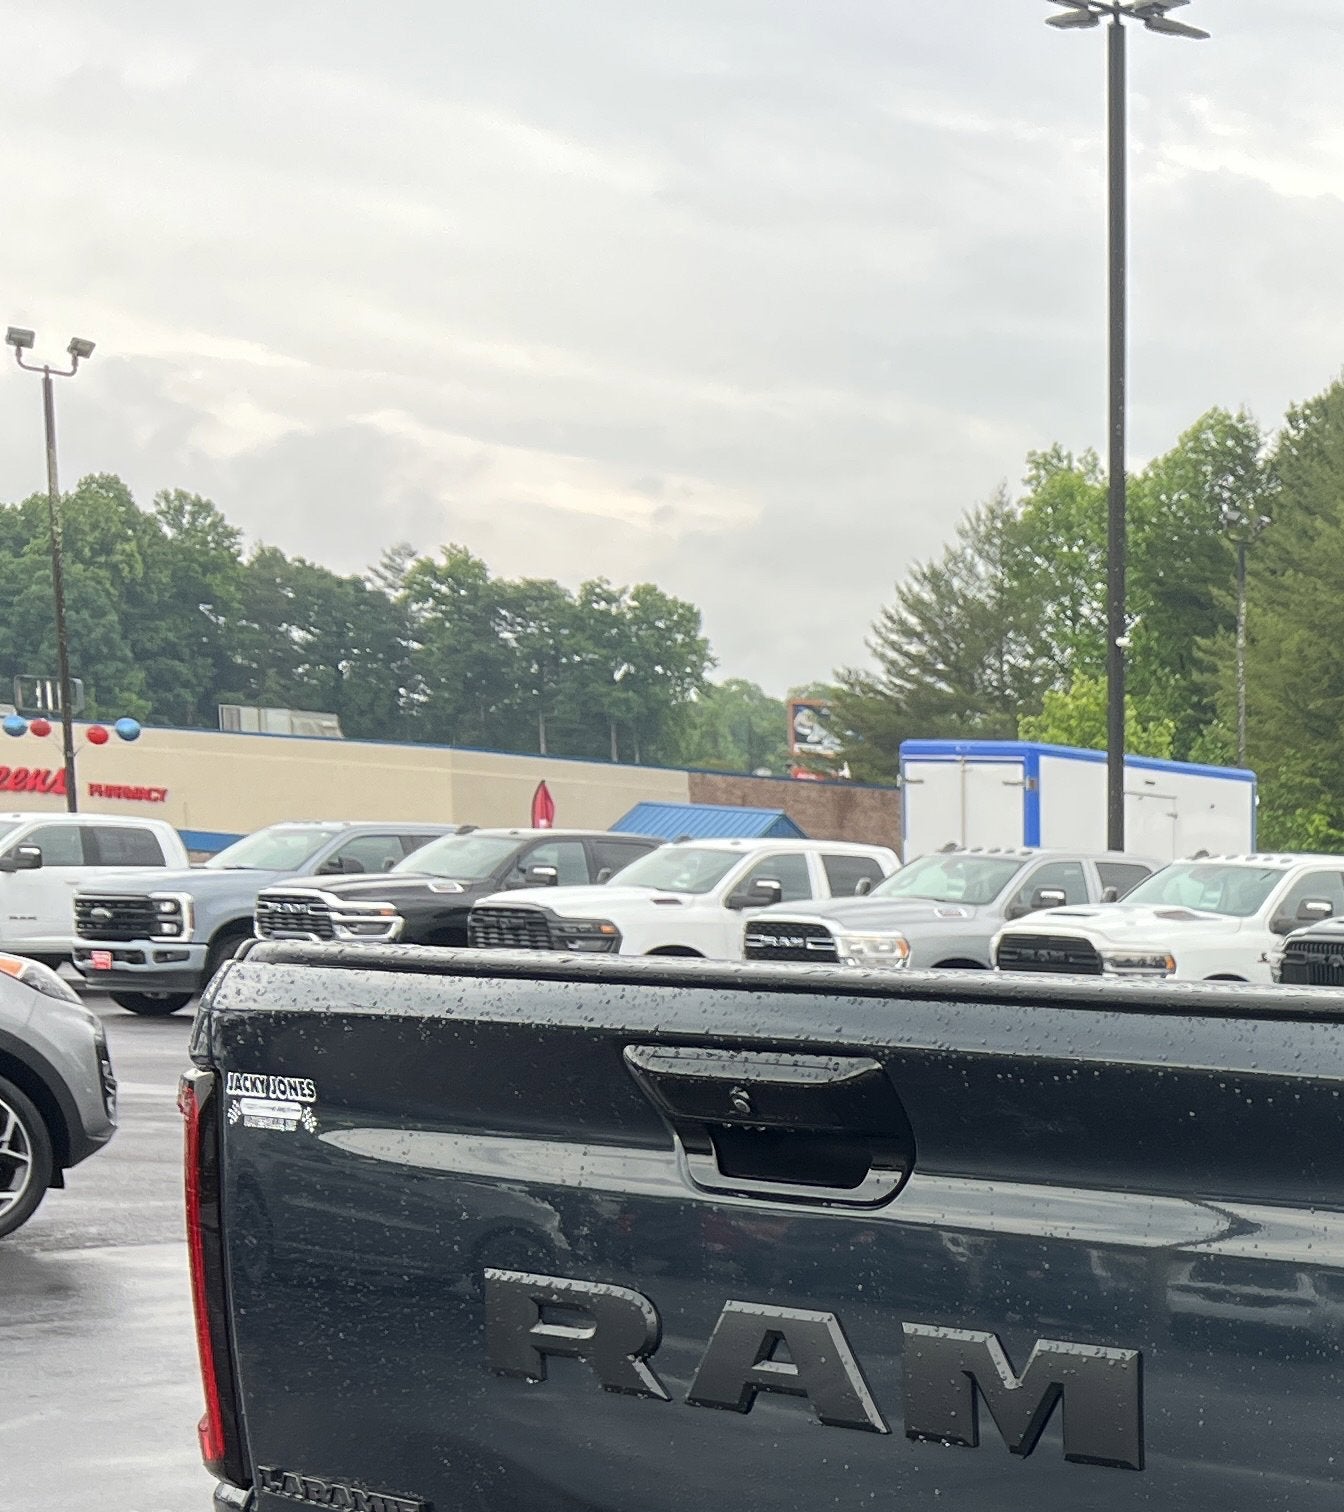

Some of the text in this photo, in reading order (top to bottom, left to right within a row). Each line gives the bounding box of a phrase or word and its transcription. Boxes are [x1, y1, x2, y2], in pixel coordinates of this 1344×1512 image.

[227, 1072, 317, 1102] JACKY JONES
[484, 1267, 1145, 1472] RAM
